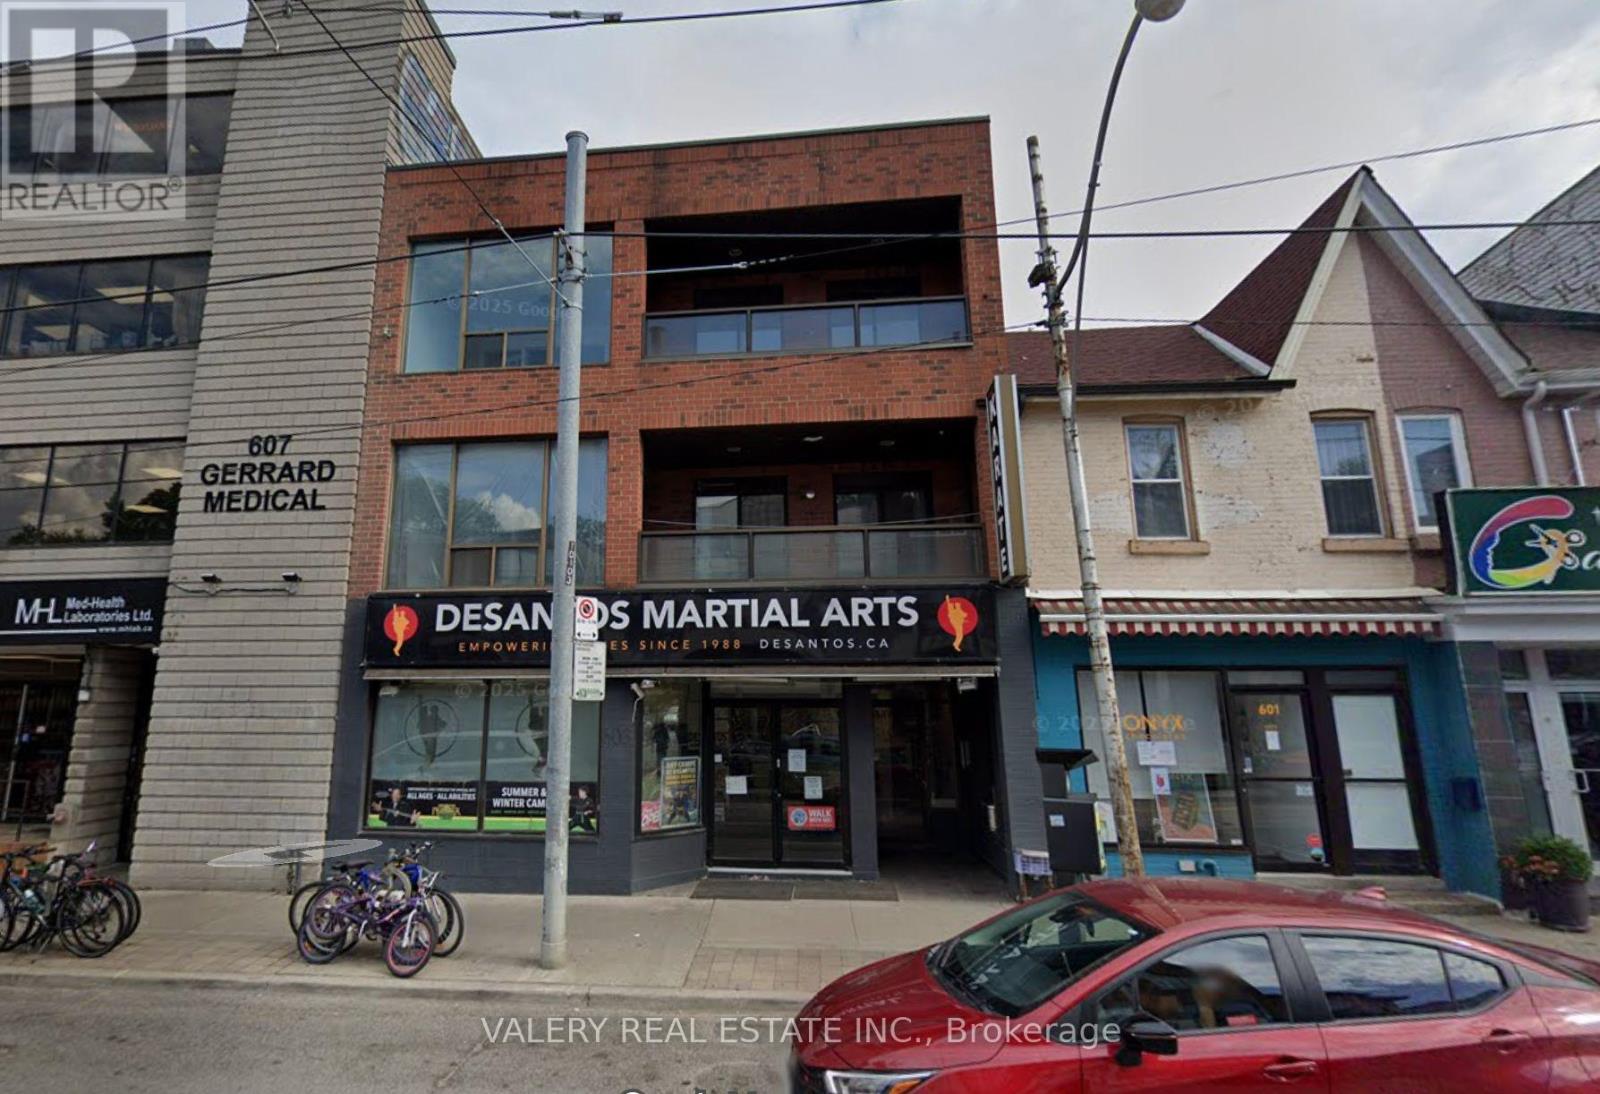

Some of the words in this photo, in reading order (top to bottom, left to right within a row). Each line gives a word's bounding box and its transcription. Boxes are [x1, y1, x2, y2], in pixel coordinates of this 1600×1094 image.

[248, 434, 293, 456] 607
[200, 459, 336, 486] GERRARD
[203, 488, 326, 513] MEDICAL
[64, 595, 126, 610] Med-Health
[63, 611, 130, 623] Laboratories
[132, 609, 154, 622] Ltd.
[435, 600, 630, 632] DESANS
[643, 598, 810, 629] MARTIAL
[820, 596, 919, 628] ARTS
[459, 641, 548, 653] EMPOWERI
[639, 639, 691, 651] SINCE
[702, 638, 741, 650] 1988
[760, 637, 889, 650] DESANTOS.CA
[1258, 704, 1280, 715] 601
[1123, 713, 1184, 731] ONYX
[501, 787, 539, 797] SUMMER
[492, 798, 525, 809] WINTER
[526, 798, 546, 808] CAM
[808, 809, 832, 817] WALK
